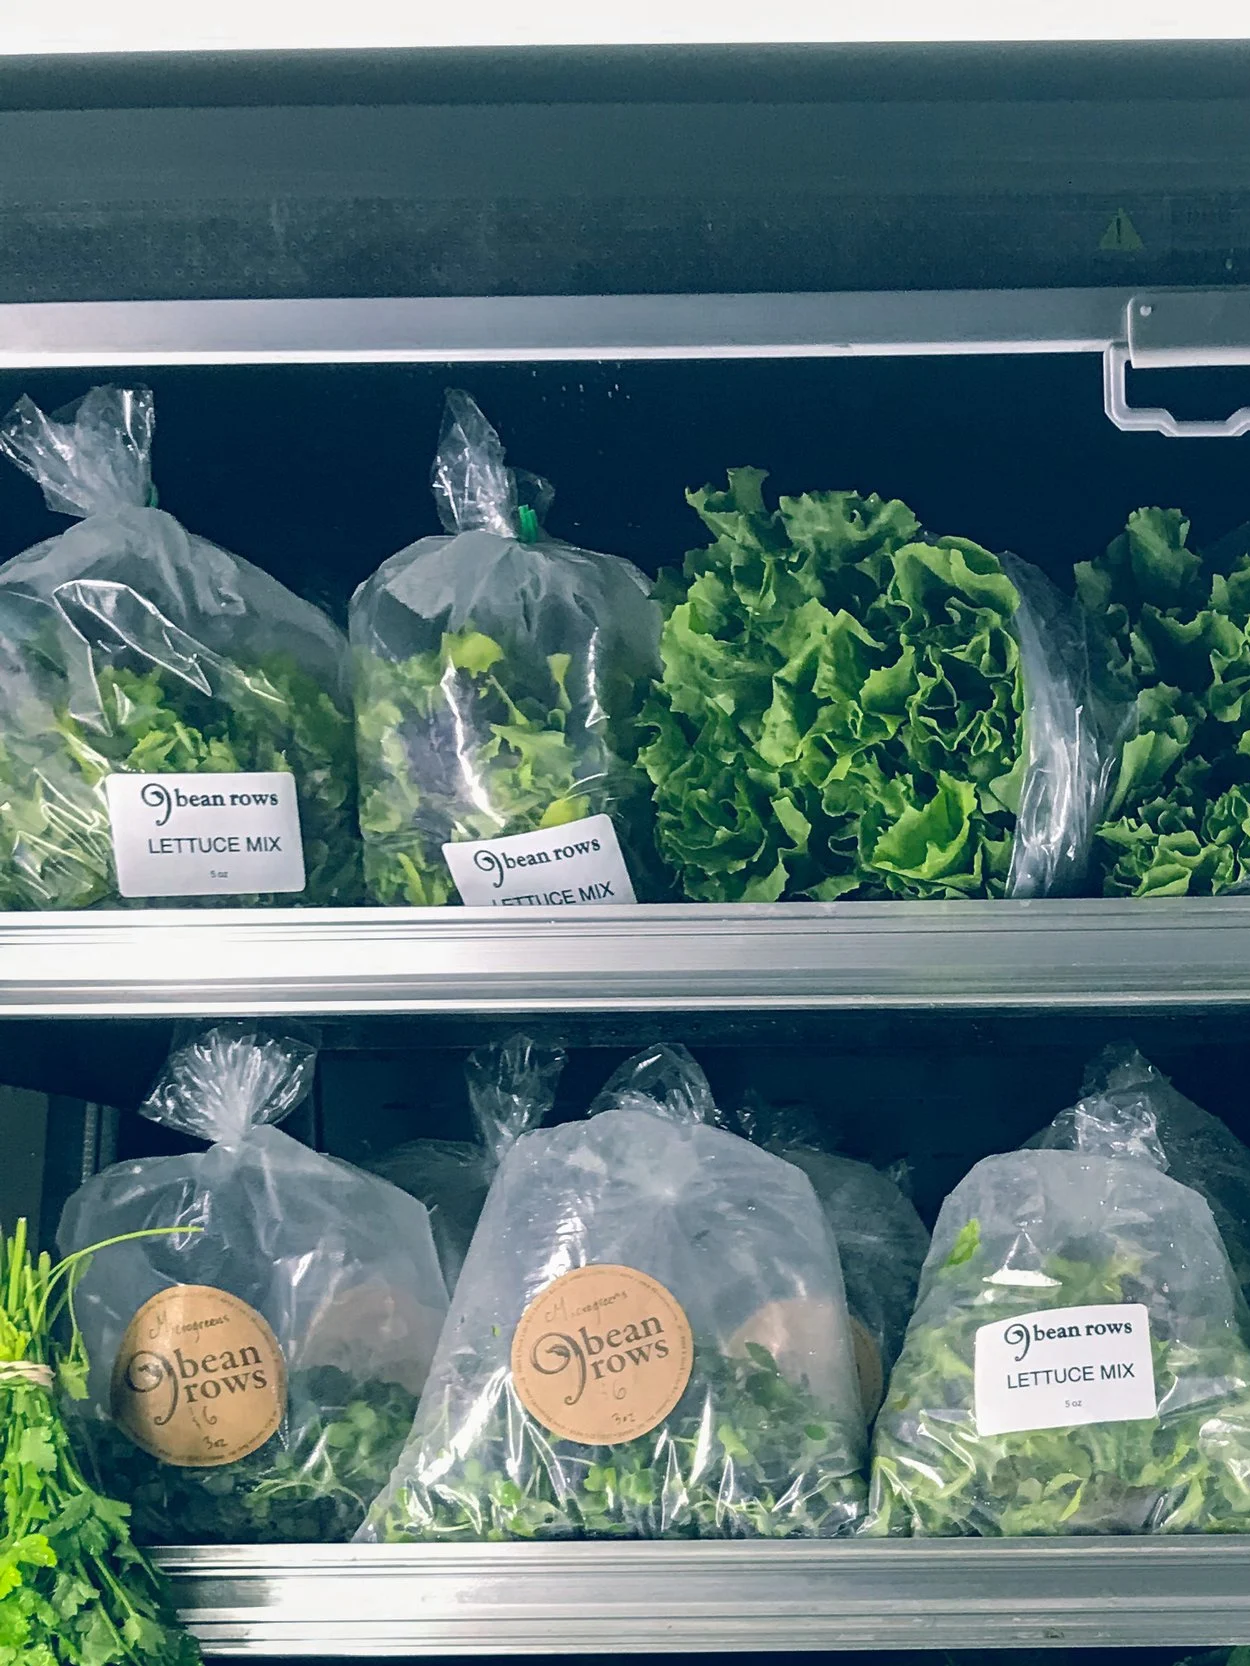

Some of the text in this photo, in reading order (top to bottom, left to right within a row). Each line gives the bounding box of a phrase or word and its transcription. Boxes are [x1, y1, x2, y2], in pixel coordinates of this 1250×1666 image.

[174, 788, 226, 807] bean
[229, 793, 278, 806] rows
[149, 836, 282, 853] LETTUCE MIX
[501, 851, 552, 869] bean
[552, 838, 601, 860] rows
[578, 881, 615, 901] MIX
[578, 1316, 664, 1356] bean
[1032, 1324, 1082, 1342] bean
[1086, 1322, 1133, 1336] rows
[173, 1346, 263, 1379] bean
[590, 1339, 669, 1380] rows
[183, 1369, 268, 1403] rows
[1007, 1363, 1135, 1390] LETTUCE MIX
